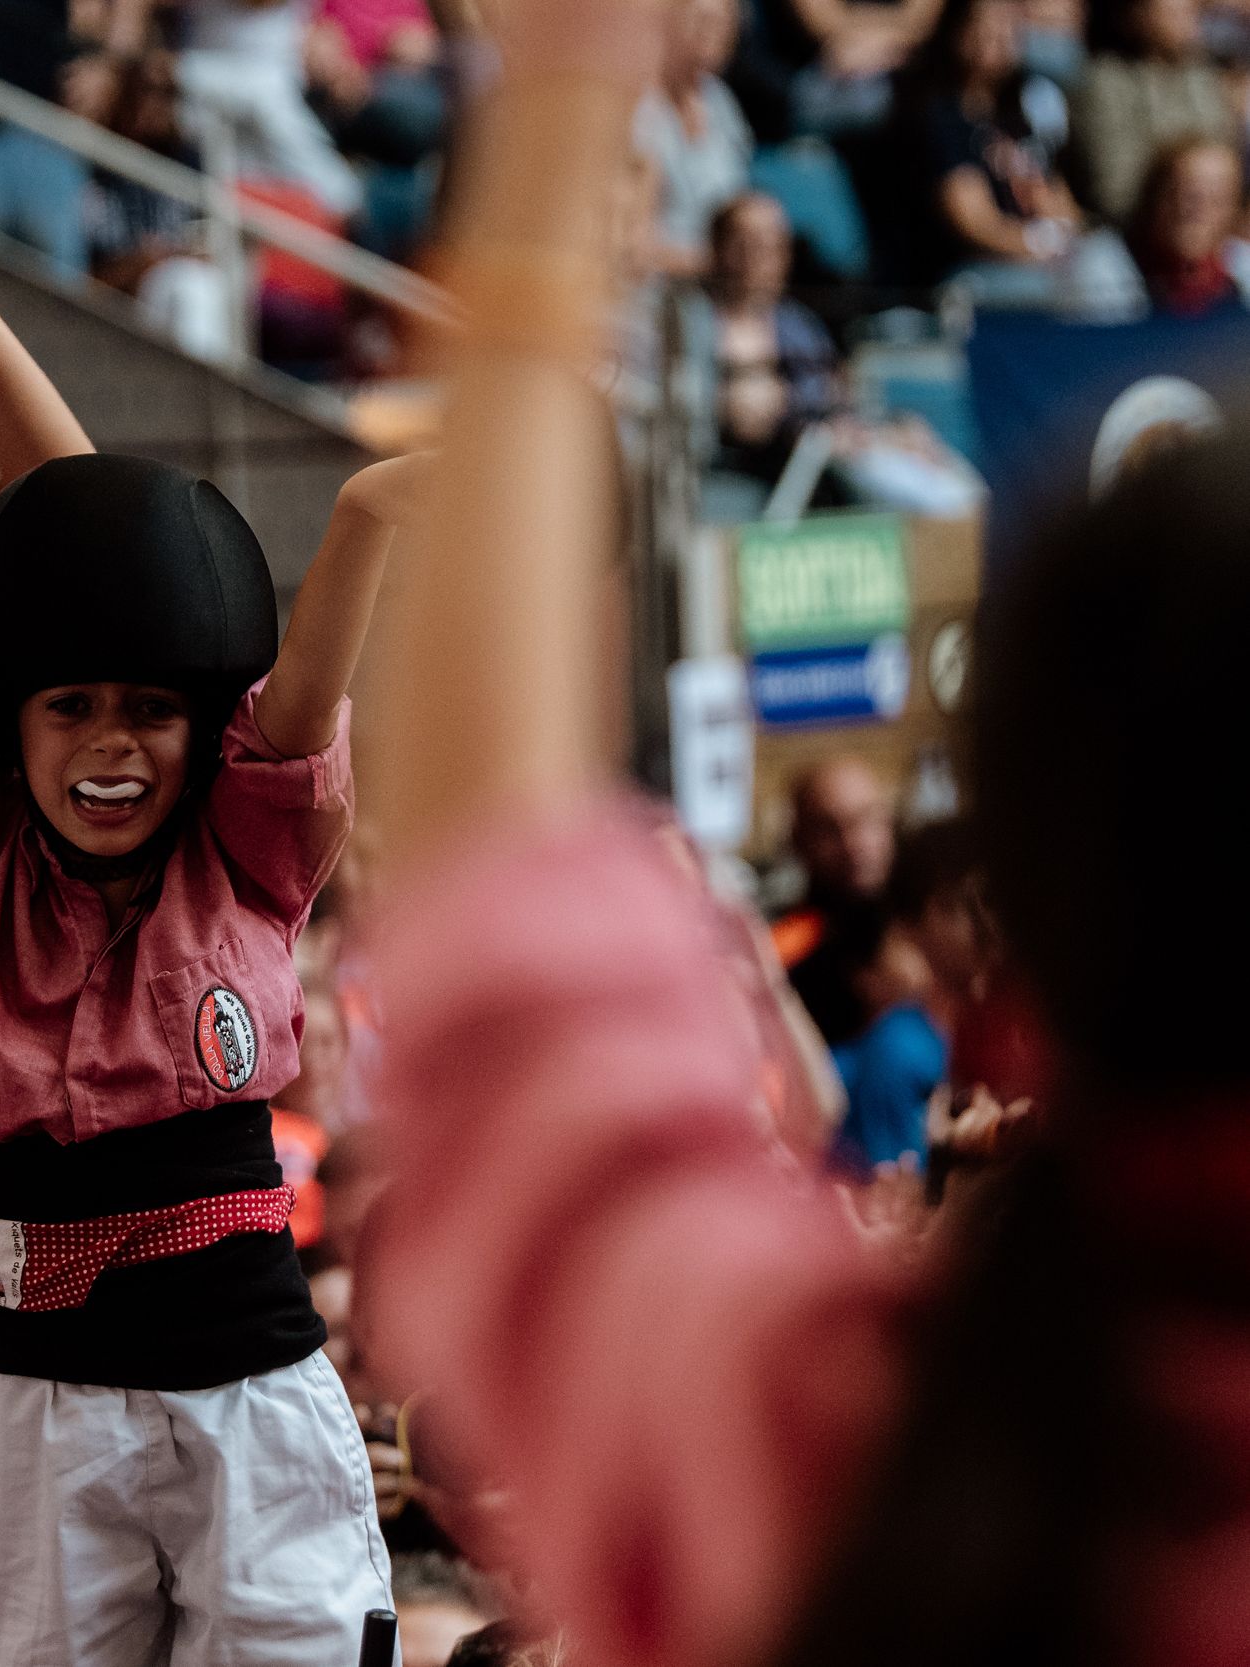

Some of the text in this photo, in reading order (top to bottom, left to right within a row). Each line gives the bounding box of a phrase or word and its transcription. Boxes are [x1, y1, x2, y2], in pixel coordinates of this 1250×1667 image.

[202, 1006, 224, 1080] COLLA VELLA
[234, 1007, 248, 1033] Xiquets
[245, 1034, 251, 1044] de
[11, 1222, 24, 1298] Xiquets de Valls
